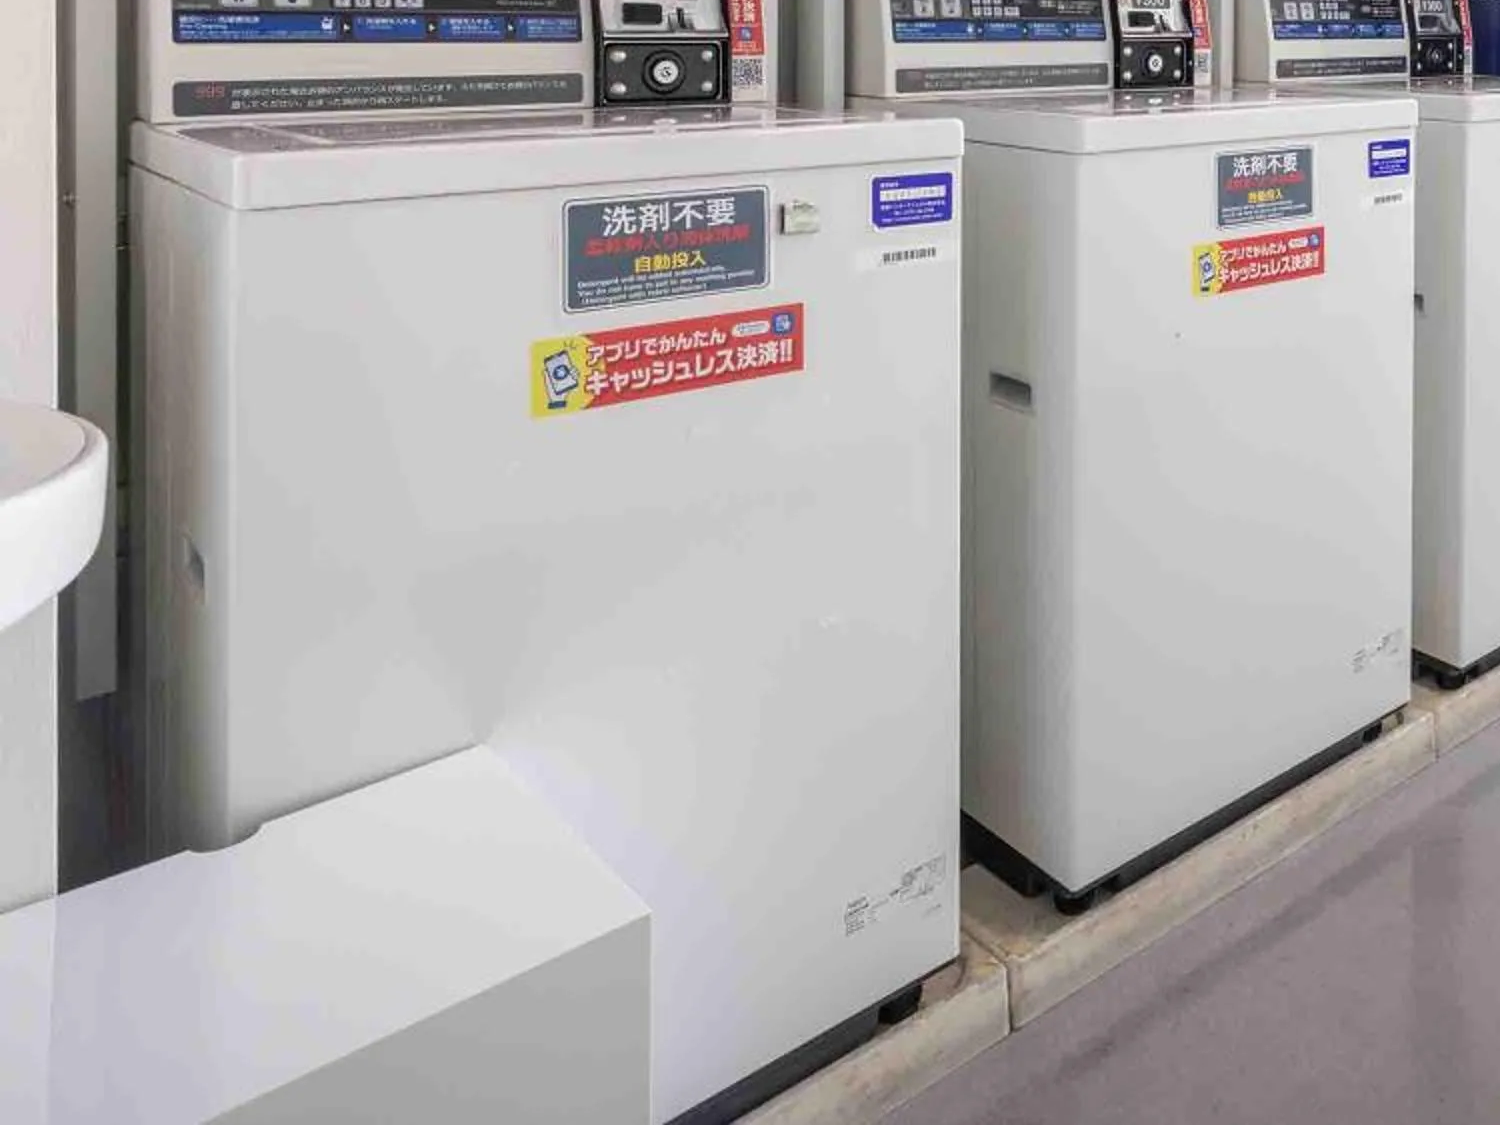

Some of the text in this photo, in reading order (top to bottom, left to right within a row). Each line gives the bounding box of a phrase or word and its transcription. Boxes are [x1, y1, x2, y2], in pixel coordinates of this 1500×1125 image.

[1233, 153, 1298, 177] 洗剤不要
[602, 196, 736, 237] 洗剤不要
[634, 250, 707, 274] 自動投入
[587, 328, 726, 365] アプリでかんたん
[585, 338, 793, 396] キャッシュレス決済!!
